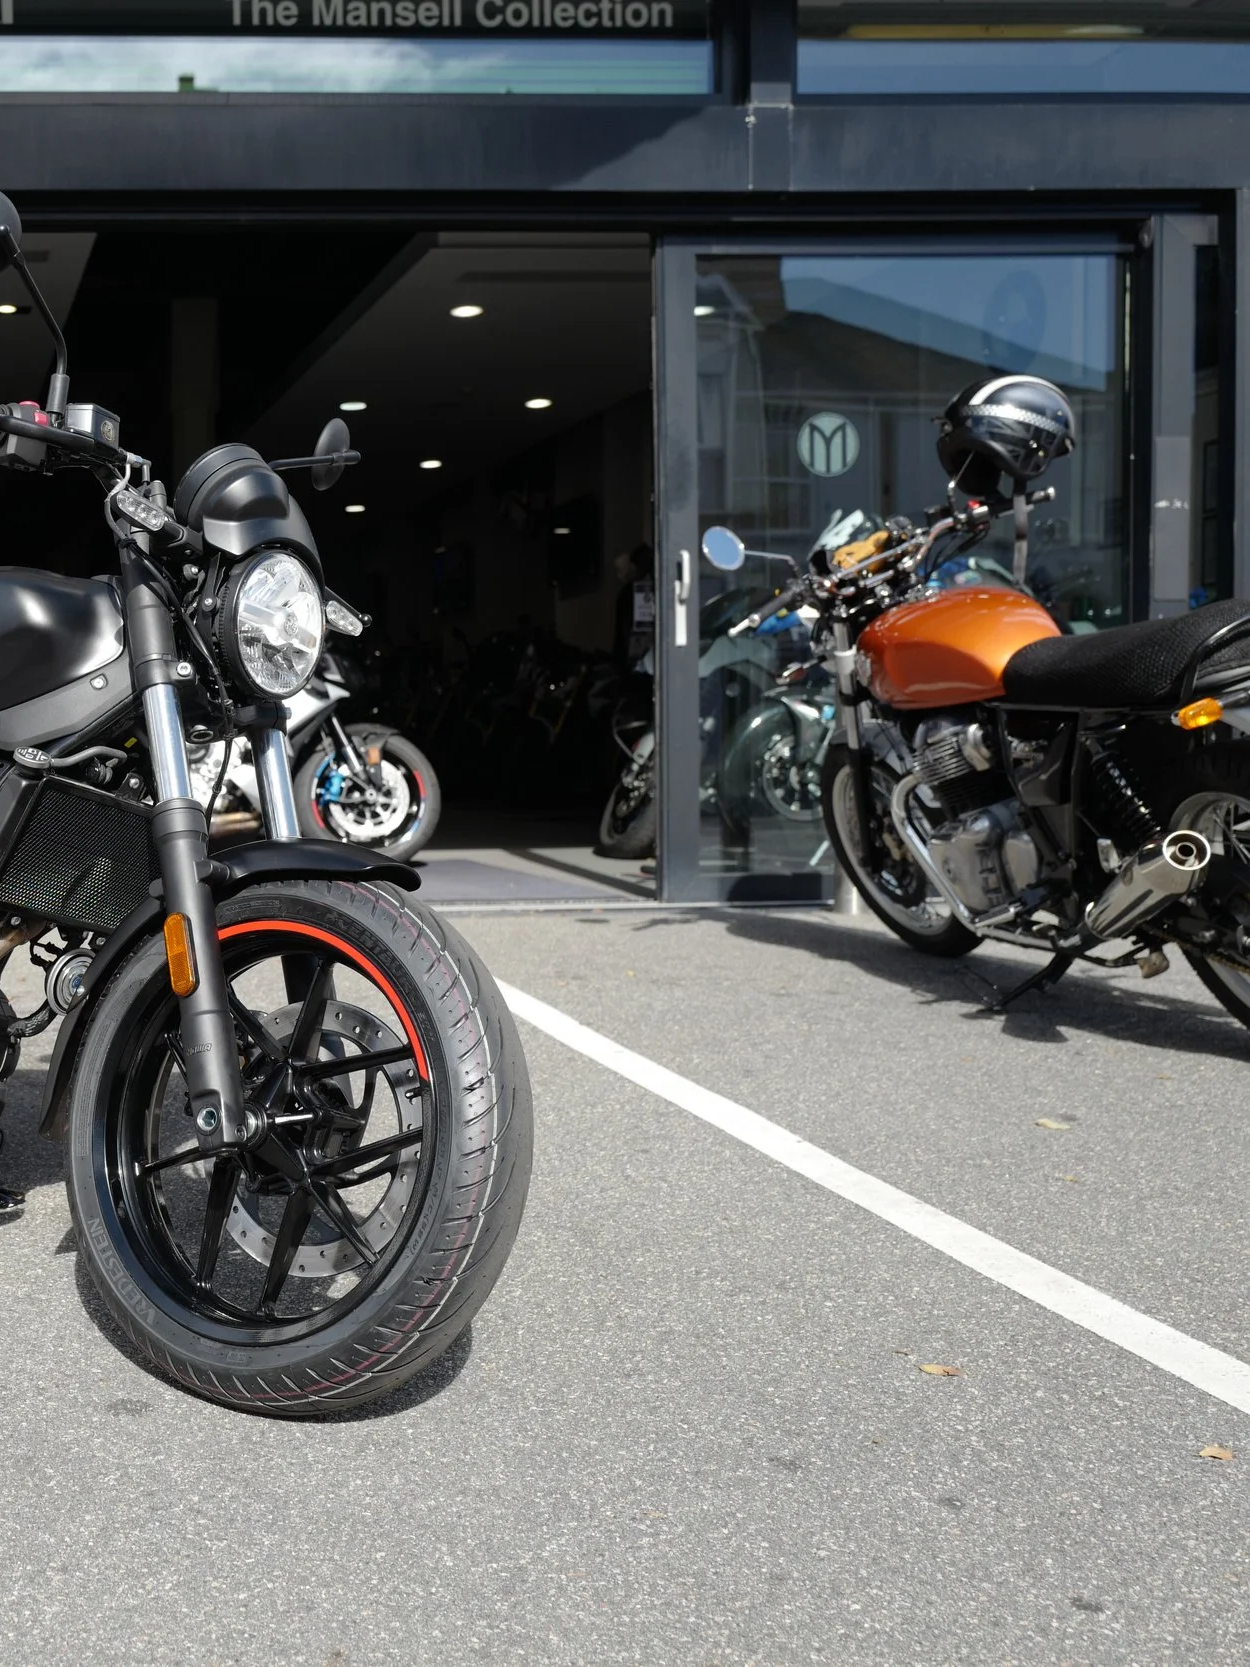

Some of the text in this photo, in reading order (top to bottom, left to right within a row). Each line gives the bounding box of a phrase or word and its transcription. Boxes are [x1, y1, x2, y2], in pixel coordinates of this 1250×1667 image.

[229, 0, 673, 28] The Mansell Collection
[87, 1217, 156, 1326] VREDESTEIN
